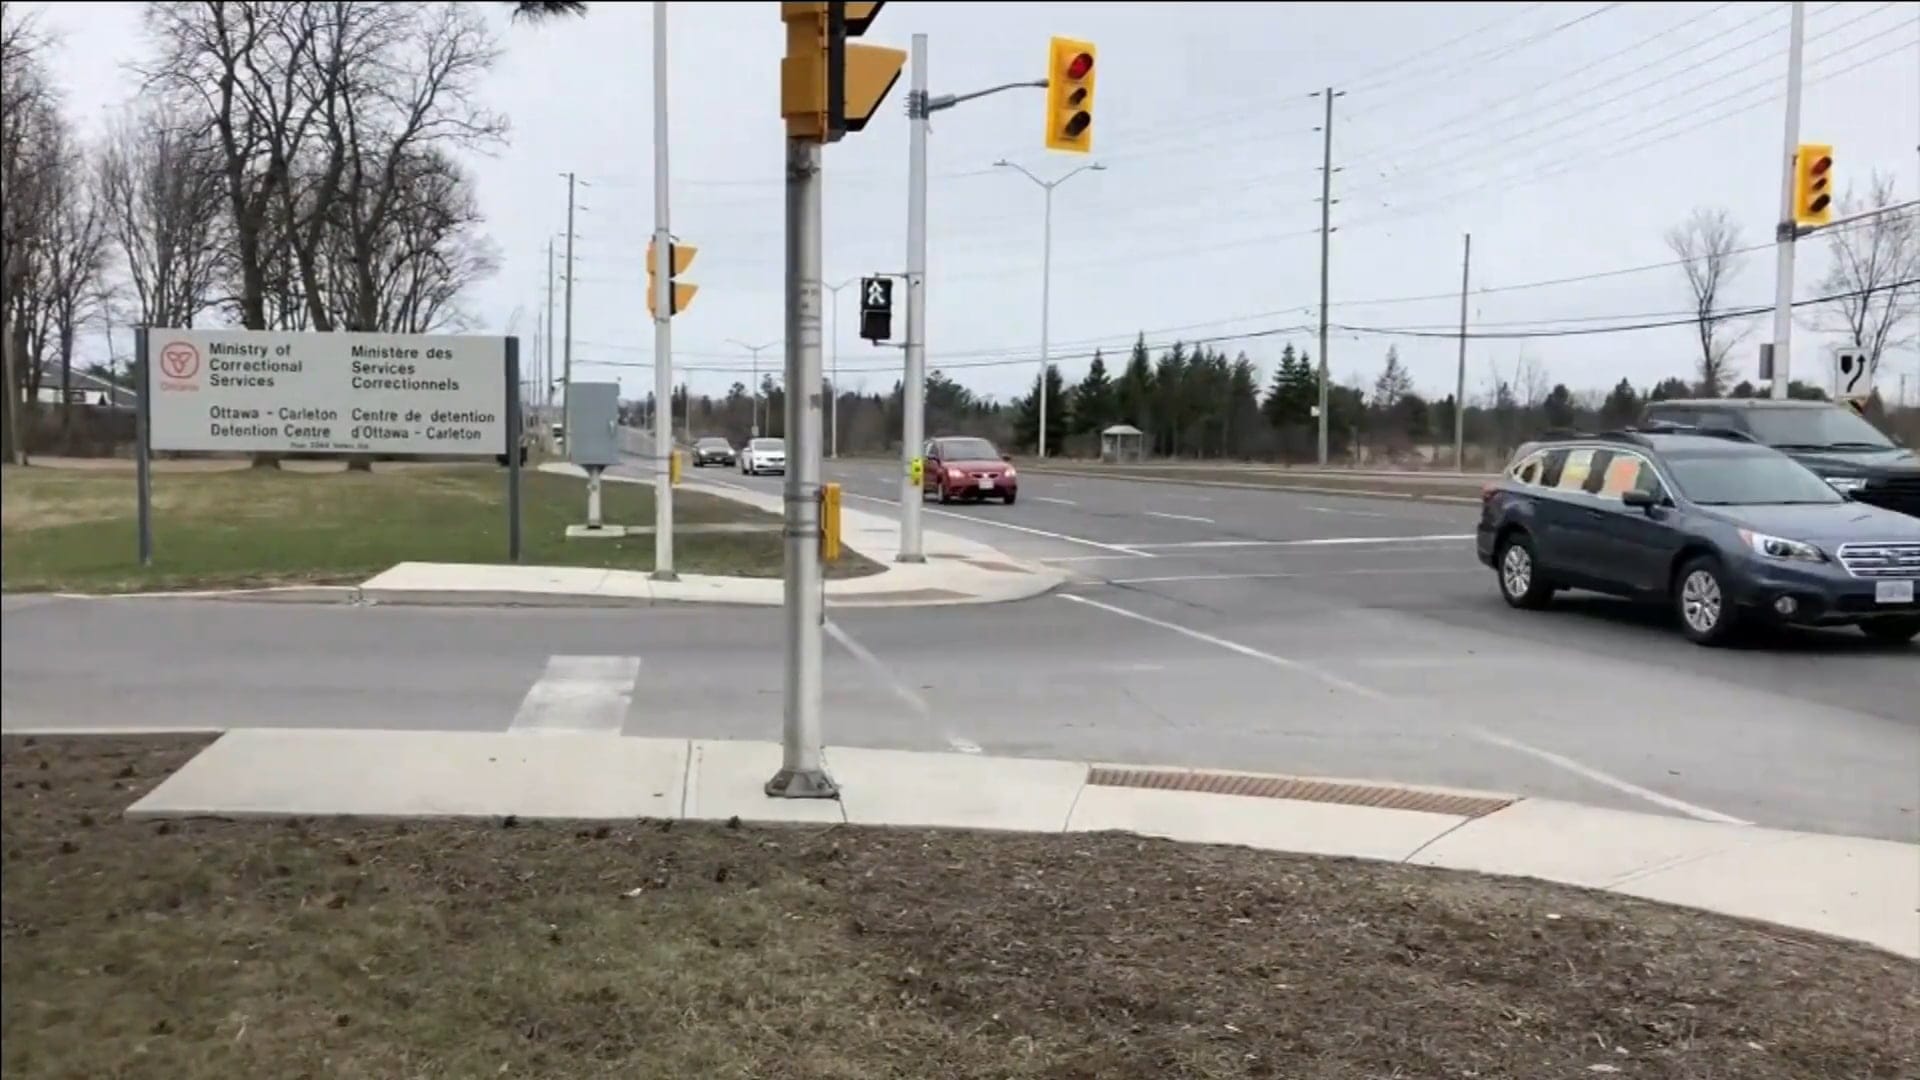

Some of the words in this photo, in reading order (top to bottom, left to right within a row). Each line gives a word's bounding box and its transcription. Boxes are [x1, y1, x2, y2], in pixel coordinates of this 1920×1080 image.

[209, 342, 269, 358] Ministry
[275, 343, 292, 356] of
[425, 347, 453, 360] des
[209, 359, 303, 373] Correctional
[351, 361, 416, 375] Services
[209, 373, 275, 387] Services
[351, 376, 460, 391] Correctionnels
[209, 405, 260, 420] Ottawa
[278, 407, 338, 422] Carleton
[351, 408, 399, 423] Centre
[404, 410, 423, 423] de
[210, 423, 279, 438] Detention
[283, 424, 331, 439] Centre
[351, 425, 410, 440] d'Ottawa
[425, 426, 482, 441] Carleton
